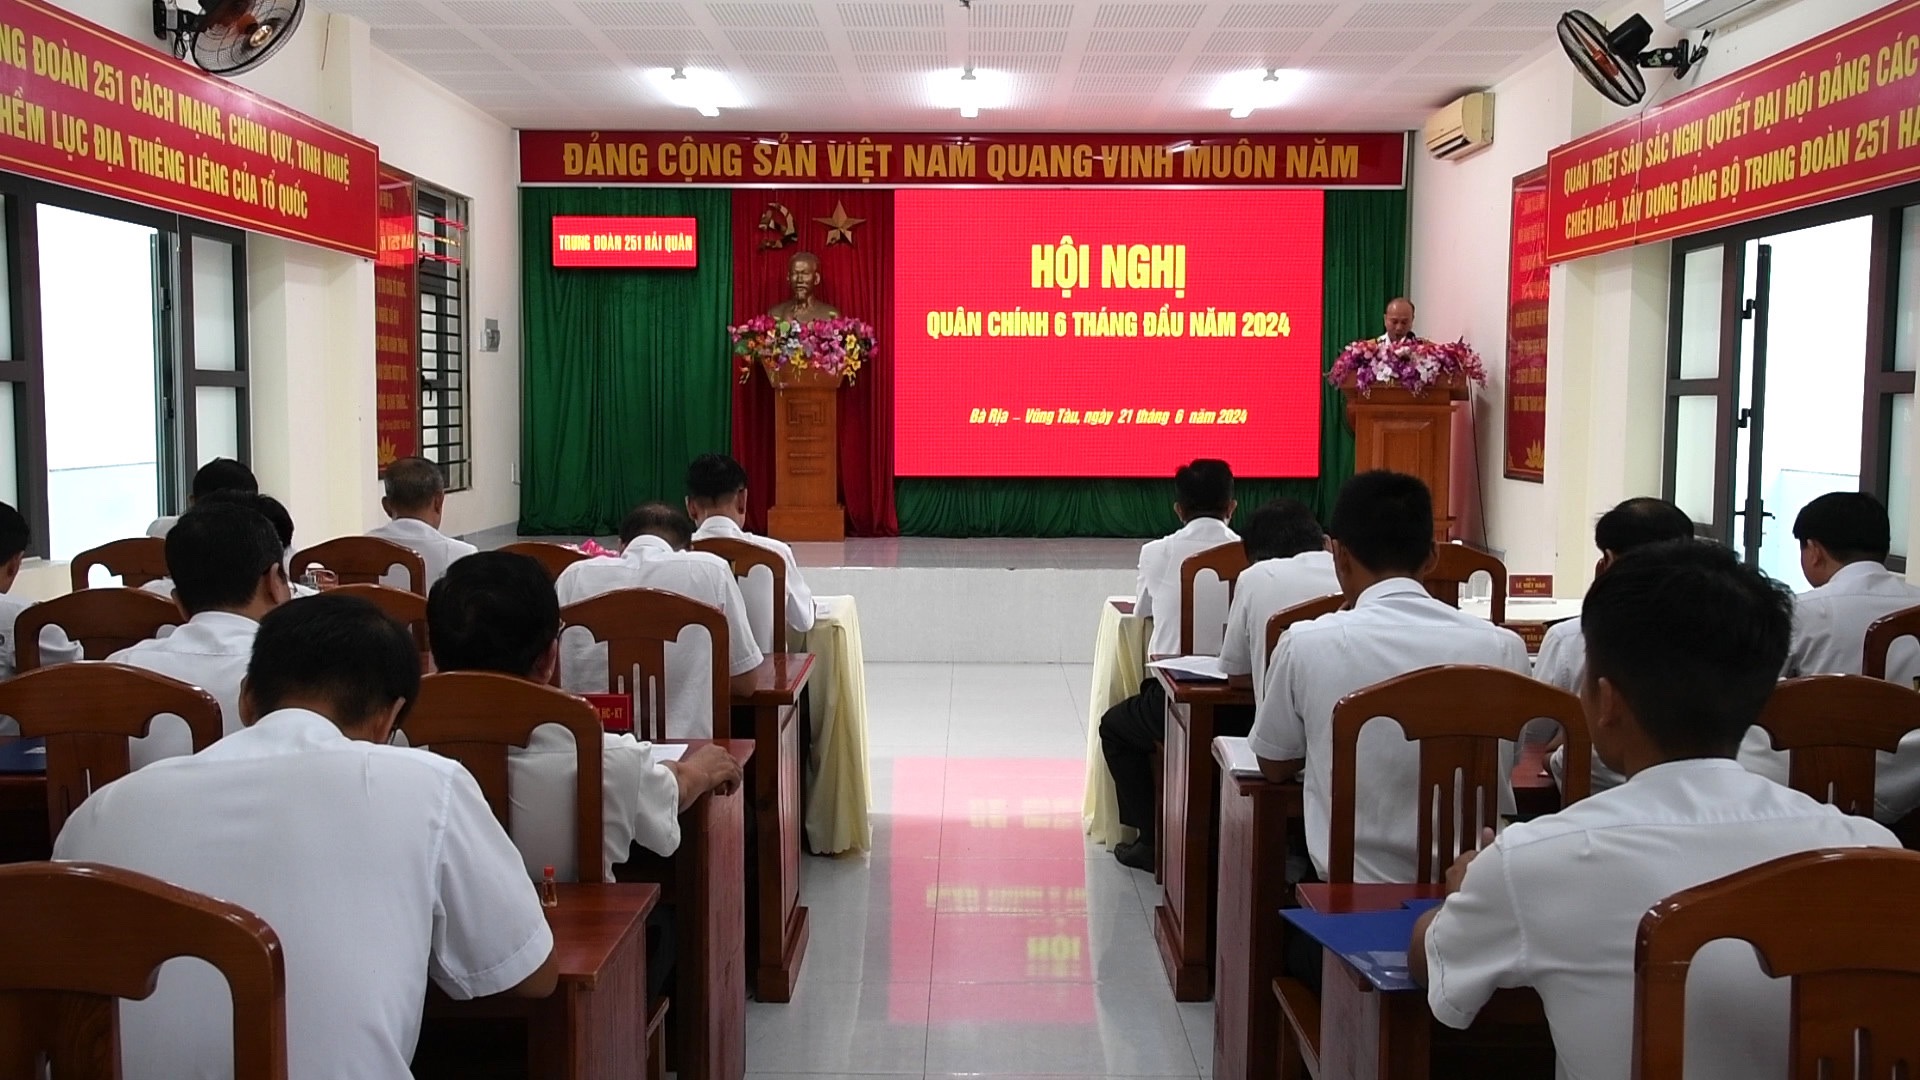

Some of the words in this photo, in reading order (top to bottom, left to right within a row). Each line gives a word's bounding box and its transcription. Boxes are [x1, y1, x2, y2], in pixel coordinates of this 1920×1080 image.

[32, 35, 88, 92] ĐOÀN
[93, 60, 124, 105] 251
[131, 73, 174, 123] CÁCH
[178, 94, 226, 145] MẠNG,
[229, 113, 267, 156] CHÍNH
[270, 130, 294, 170] QUY,
[296, 140, 321, 176] TINH
[323, 151, 350, 191] NHUỆ
[1563, 158, 1589, 198] QUÁN
[1592, 147, 1619, 187] TRIỆT
[1620, 139, 1644, 177] SÂU
[1645, 123, 1670, 168] SẮC
[1672, 118, 1703, 157] NGHỊ
[1706, 91, 1750, 150] QUYẾT
[1753, 88, 1781, 135] ĐẠI
[1784, 71, 1814, 124] HỘI
[1818, 52, 1871, 109] ĐẢNG
[1876, 31, 1919, 88] CÁC
[52, 110, 89, 161] LỤC
[93, 123, 125, 172] ĐỊA
[128, 135, 186, 185] THIÊNG
[189, 152, 229, 197] LIÊNG
[232, 161, 259, 206] CỦA
[260, 169, 275, 210] TỔ
[278, 179, 308, 219] QUỐC
[563, 131, 648, 176] ĐẢNG
[658, 135, 742, 182] CỘNG
[752, 132, 817, 176] SẢN
[827, 137, 892, 183] VIỆT
[904, 144, 976, 177] NAM
[987, 144, 1093, 181] QUANG
[1101, 145, 1174, 178] VINH
[1183, 137, 1276, 178] MUÔN
[1286, 137, 1359, 178] NĂM
[1565, 200, 1593, 240] CHIẾN
[1595, 192, 1619, 231] ĐẤU,
[1621, 188, 1644, 226] XÂY
[1645, 181, 1678, 224] DỰNG
[1681, 165, 1717, 210] ĐẢNG
[1720, 155, 1741, 203] BỘ
[1745, 144, 1796, 192] TRUNG
[1800, 125, 1850, 177] ĐOÀN
[1854, 115, 1890, 162] 251
[559, 234, 590, 251] TRUNG
[593, 232, 622, 251] ĐOÀN
[624, 235, 642, 251] 251
[665, 232, 693, 253] QUÂN
[1031, 235, 1090, 298] HỘI
[1101, 244, 1186, 298] NGHỊ
[926, 306, 982, 339] QUÂN
[987, 306, 1049, 337] CHÍNH
[1054, 311, 1067, 337] 6
[1072, 306, 1138, 337] THÁNG
[1142, 303, 1185, 337] ĐẦU
[1189, 306, 1236, 337] NĂM
[1241, 312, 1291, 337] 2024
[969, 408, 987, 424] Bà
[988, 408, 1009, 427] Rịa
[1025, 408, 1055, 425] Vũng
[1057, 408, 1080, 425] Tàu,
[1083, 408, 1114, 426] ngày
[1117, 409, 1134, 424] 21
[1135, 408, 1170, 426] tháng
[1174, 409, 1185, 424] 6
[1188, 408, 1217, 424] năm
[1217, 409, 1248, 424] 2024
